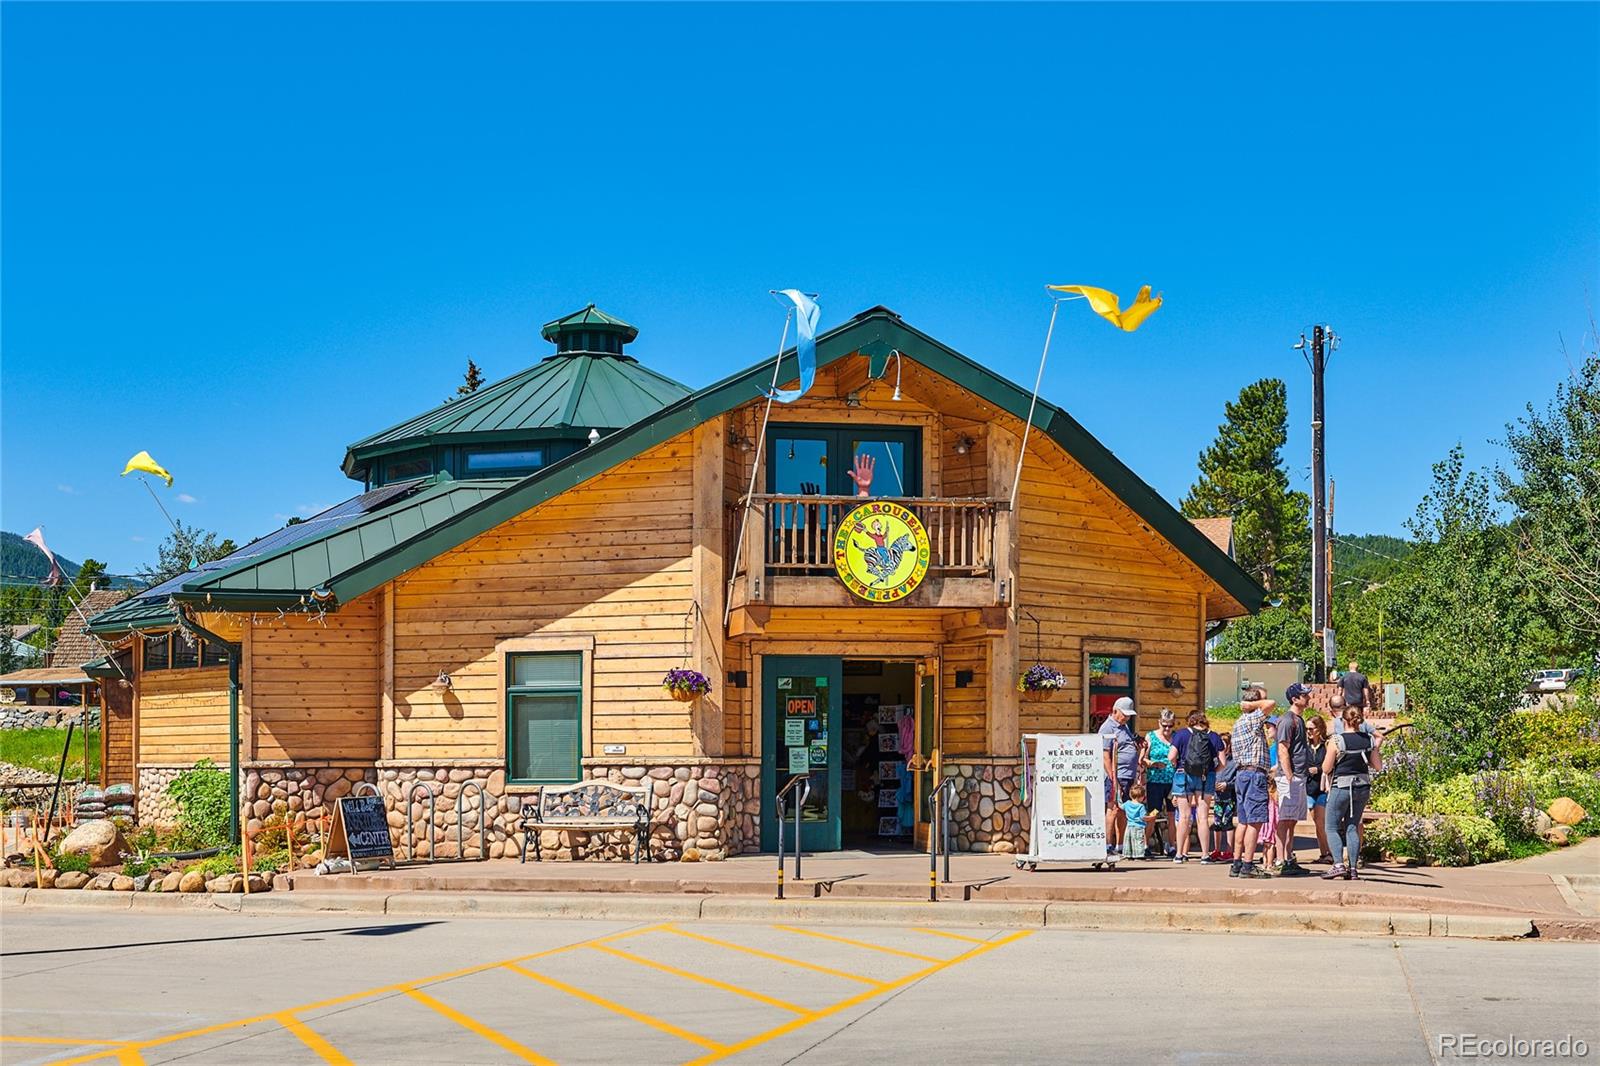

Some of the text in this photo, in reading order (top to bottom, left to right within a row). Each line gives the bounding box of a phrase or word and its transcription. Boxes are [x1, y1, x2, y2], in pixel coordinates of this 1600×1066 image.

[836, 504, 929, 600] THE CAROUSEL OF HAPPINESS
[788, 700, 814, 714] OPEN
